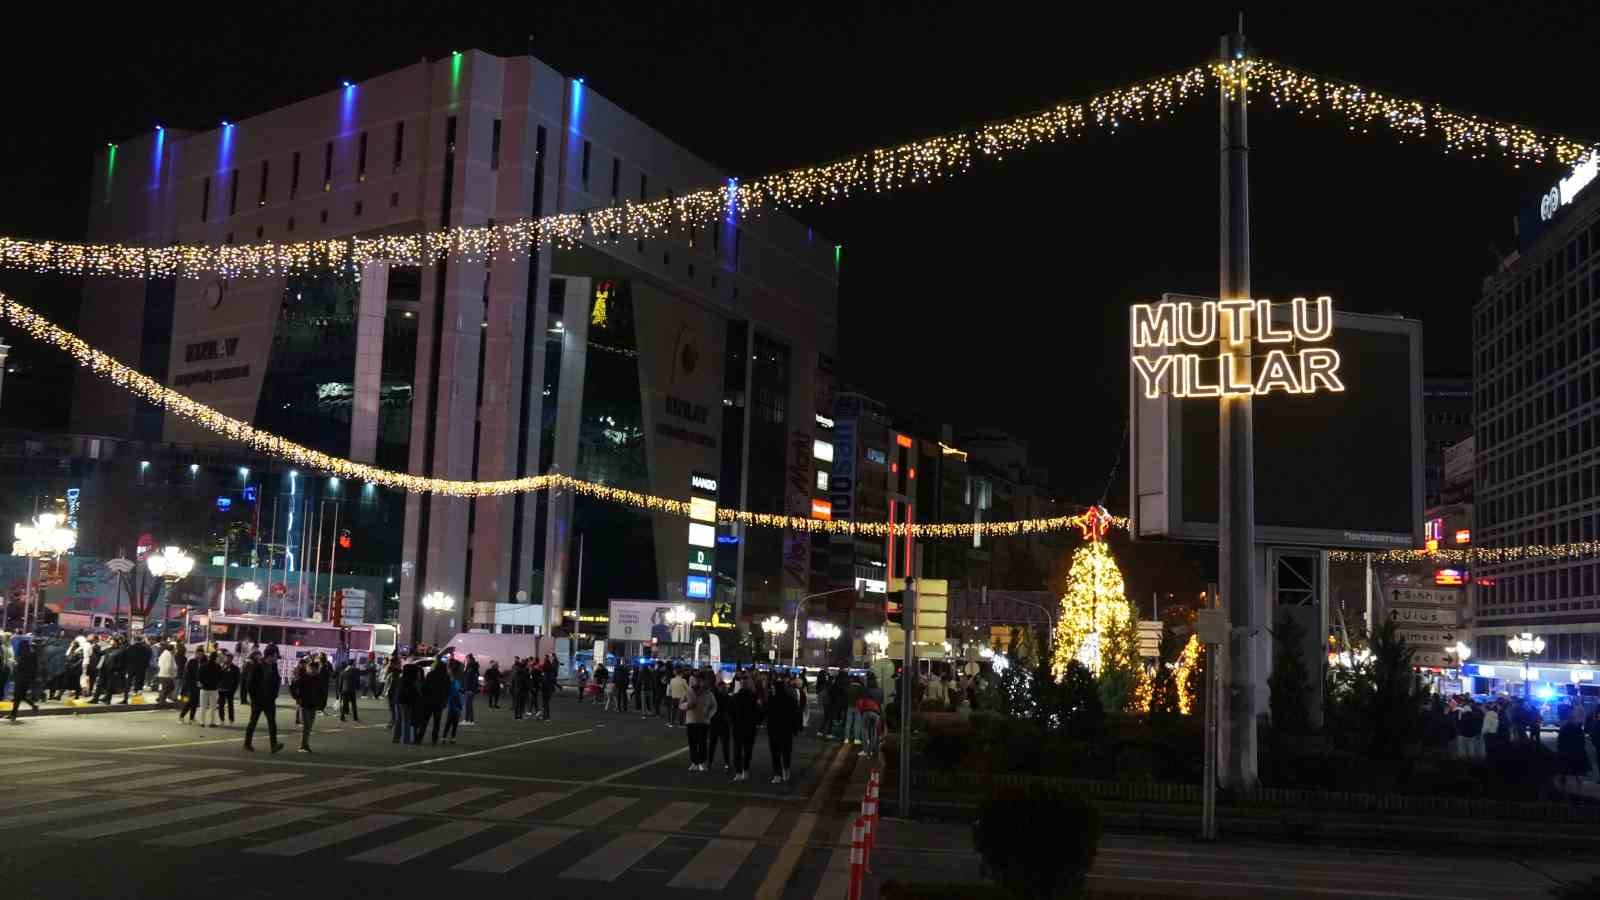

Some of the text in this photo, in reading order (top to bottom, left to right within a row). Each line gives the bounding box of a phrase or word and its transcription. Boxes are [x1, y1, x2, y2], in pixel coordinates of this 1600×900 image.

[1131, 296, 1333, 347] MUTLU
[1131, 348, 1345, 399] YILLAR
[692, 476, 717, 491] MANGO
